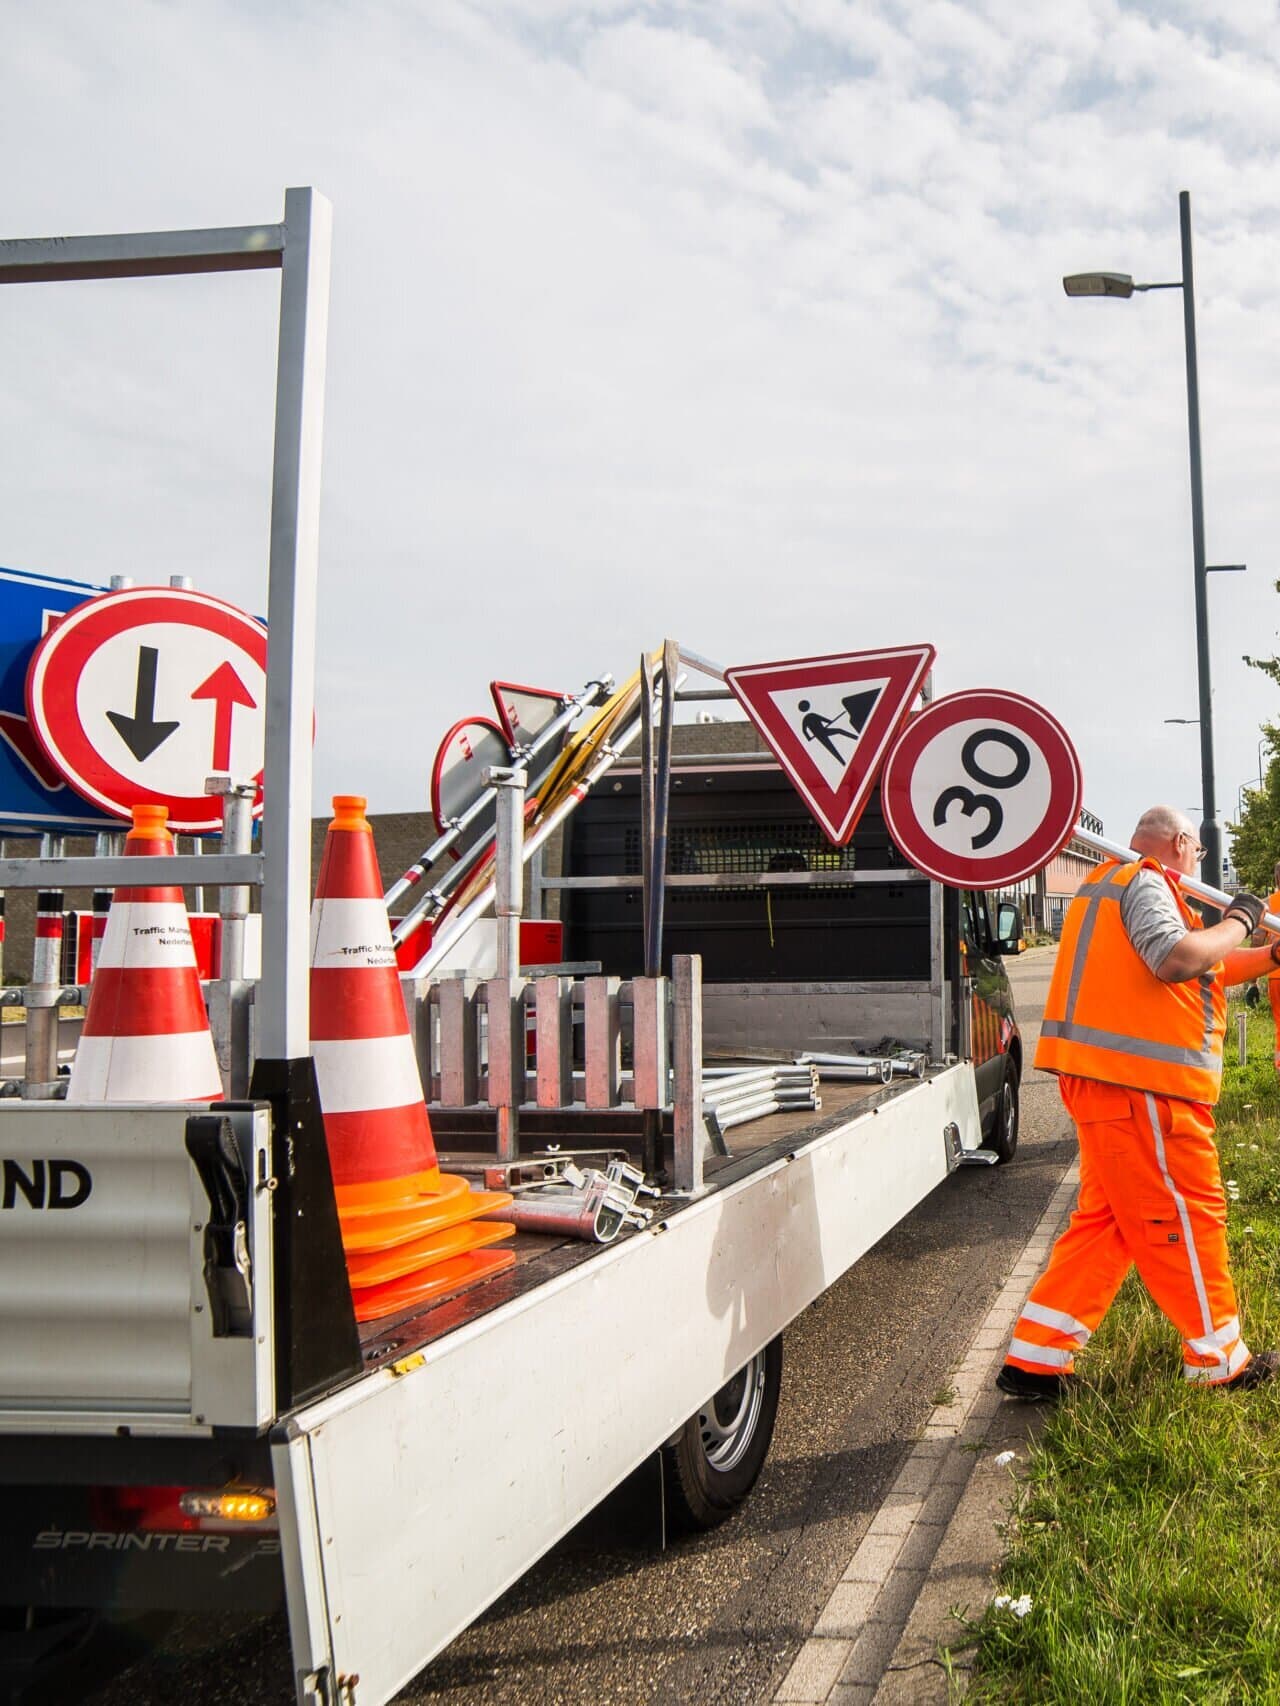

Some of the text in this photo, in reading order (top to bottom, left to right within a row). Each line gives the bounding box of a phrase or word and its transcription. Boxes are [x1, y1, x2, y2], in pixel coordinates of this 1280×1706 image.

[933, 728, 1031, 850] 30
[133, 926, 166, 936] Traffic
[341, 945, 373, 955] Traffic
[32, 1531, 230, 1553] SPRINTER
